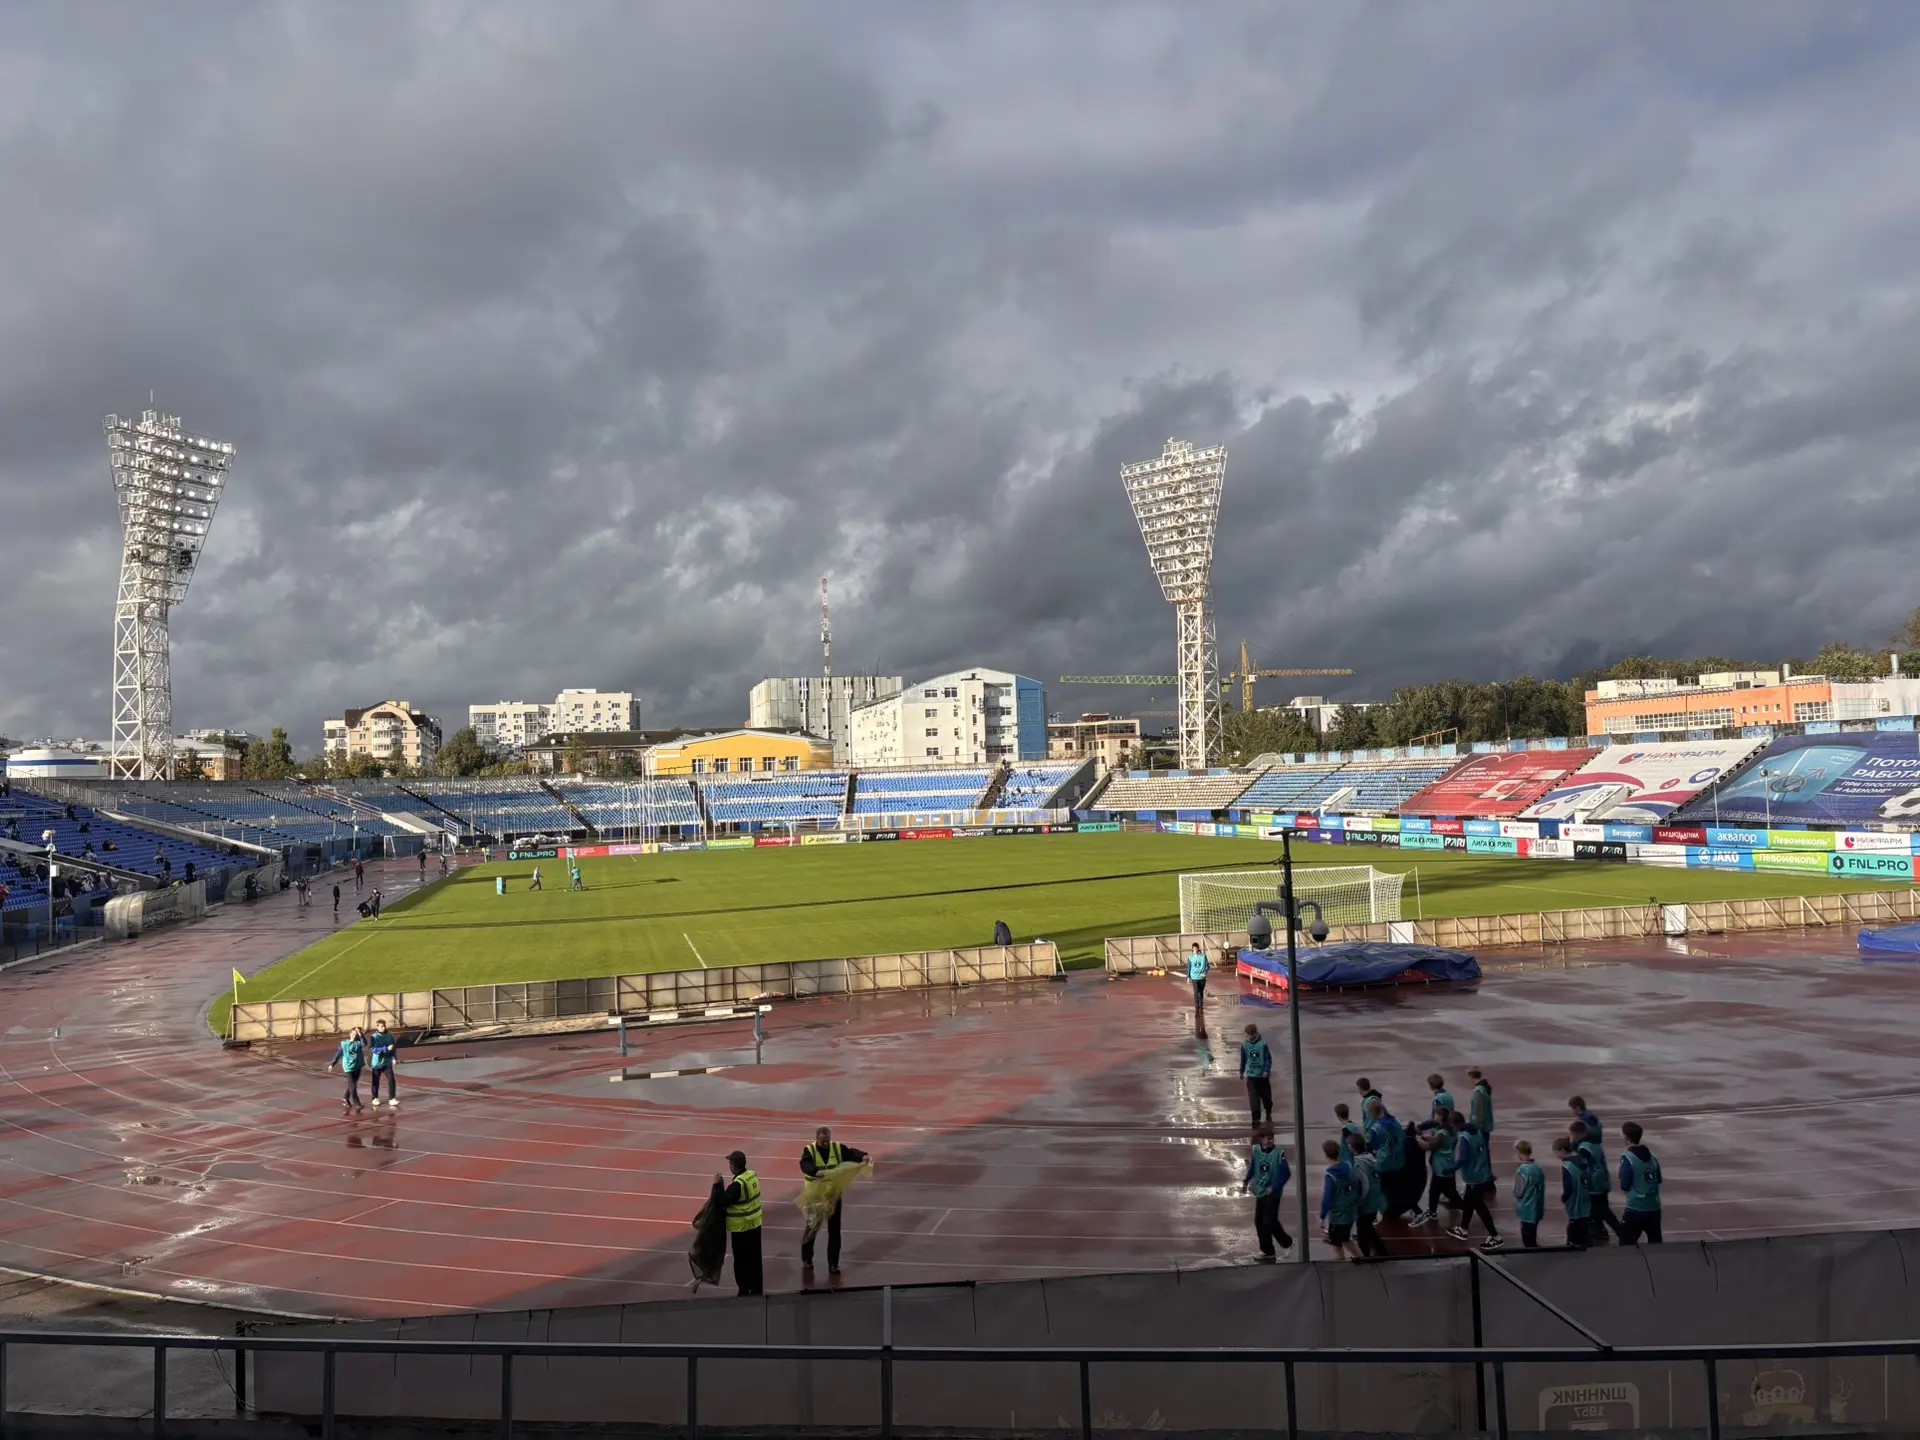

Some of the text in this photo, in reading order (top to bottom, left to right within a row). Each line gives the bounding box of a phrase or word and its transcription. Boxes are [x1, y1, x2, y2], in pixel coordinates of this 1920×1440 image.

[1380, 834, 1400, 843] PARI
[1444, 837, 1466, 847] PARI
[1856, 836, 1902, 845] НИЖФАРМ
[519, 850, 555, 858] FNL.PRO
[1576, 845, 1623, 855] PARI PARI
[1712, 850, 1740, 863] JAKO
[1848, 858, 1909, 872] FNL.PRO
